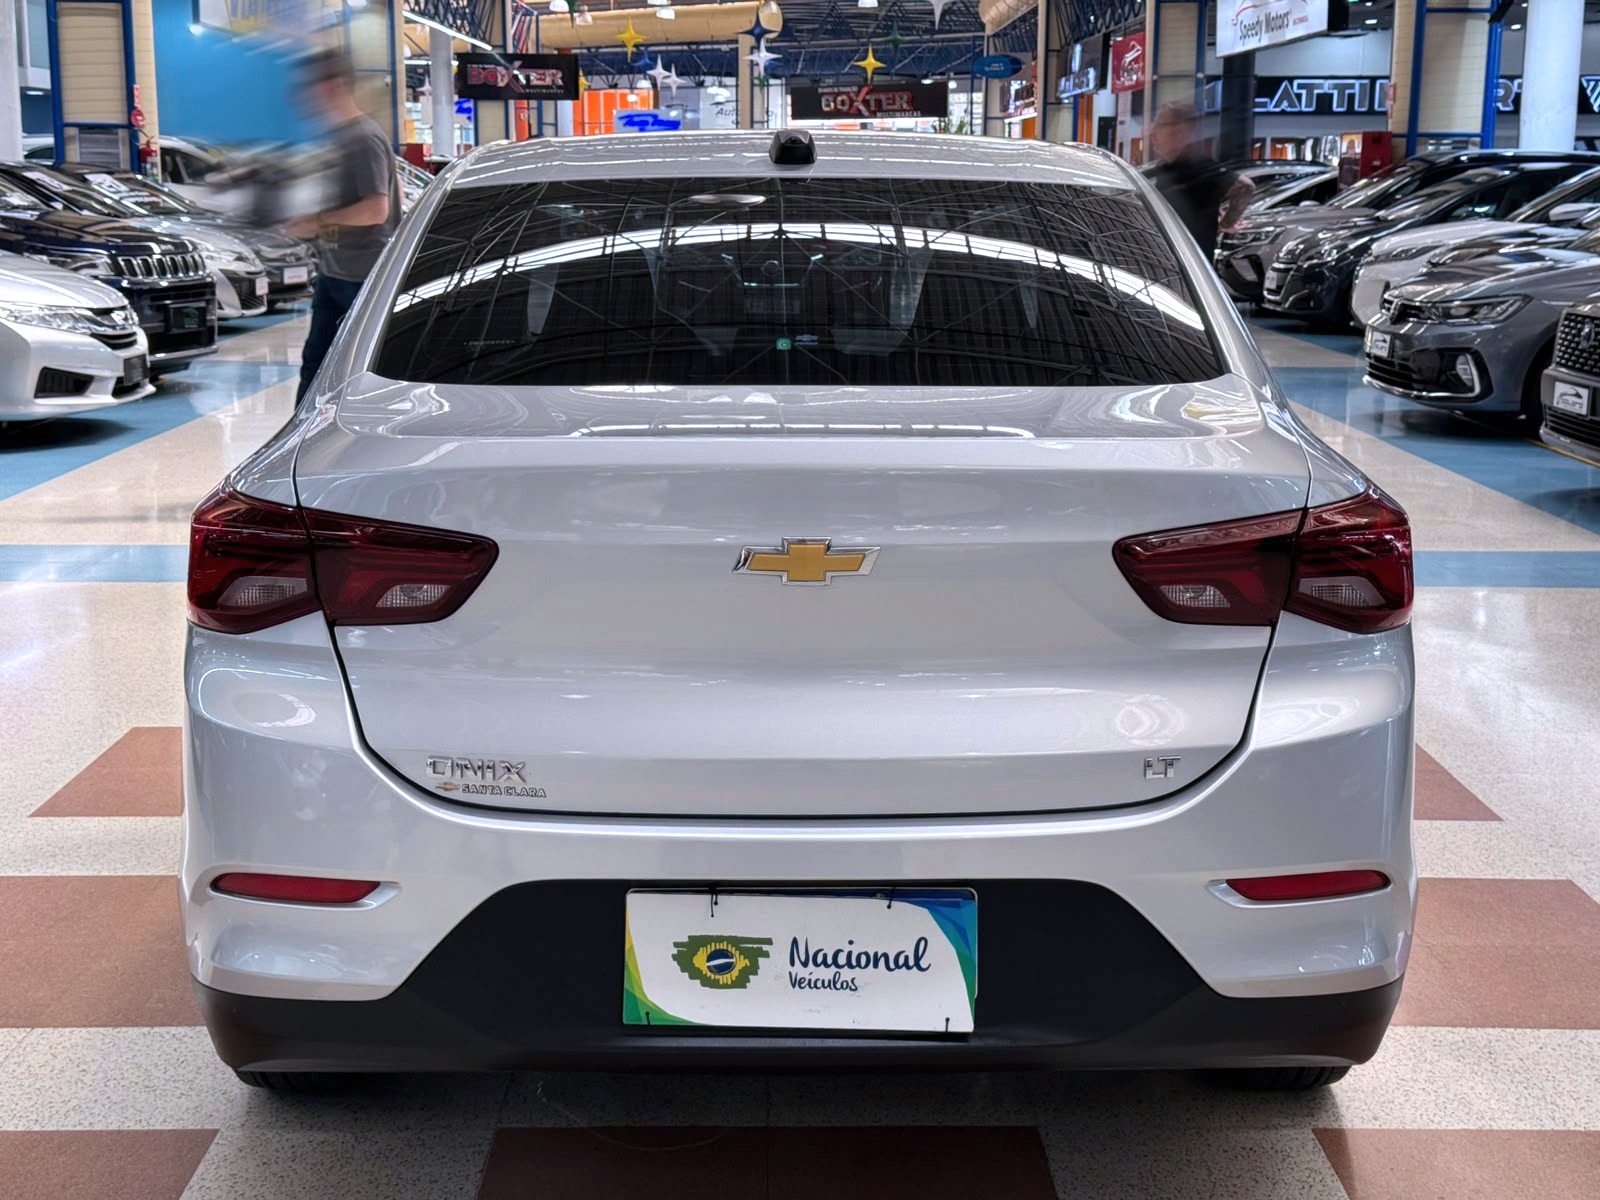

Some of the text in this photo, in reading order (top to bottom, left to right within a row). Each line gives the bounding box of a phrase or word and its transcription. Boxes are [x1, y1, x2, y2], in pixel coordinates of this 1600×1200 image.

[1239, 9, 1291, 46] Speedy Motors
[821, 86, 914, 117] BOXTER
[426, 755, 527, 783] ONIX
[1144, 755, 1181, 779] LT
[462, 783, 547, 798] SANTA CLARA
[789, 936, 931, 972] Nacional
[788, 971, 858, 992] Veículos
